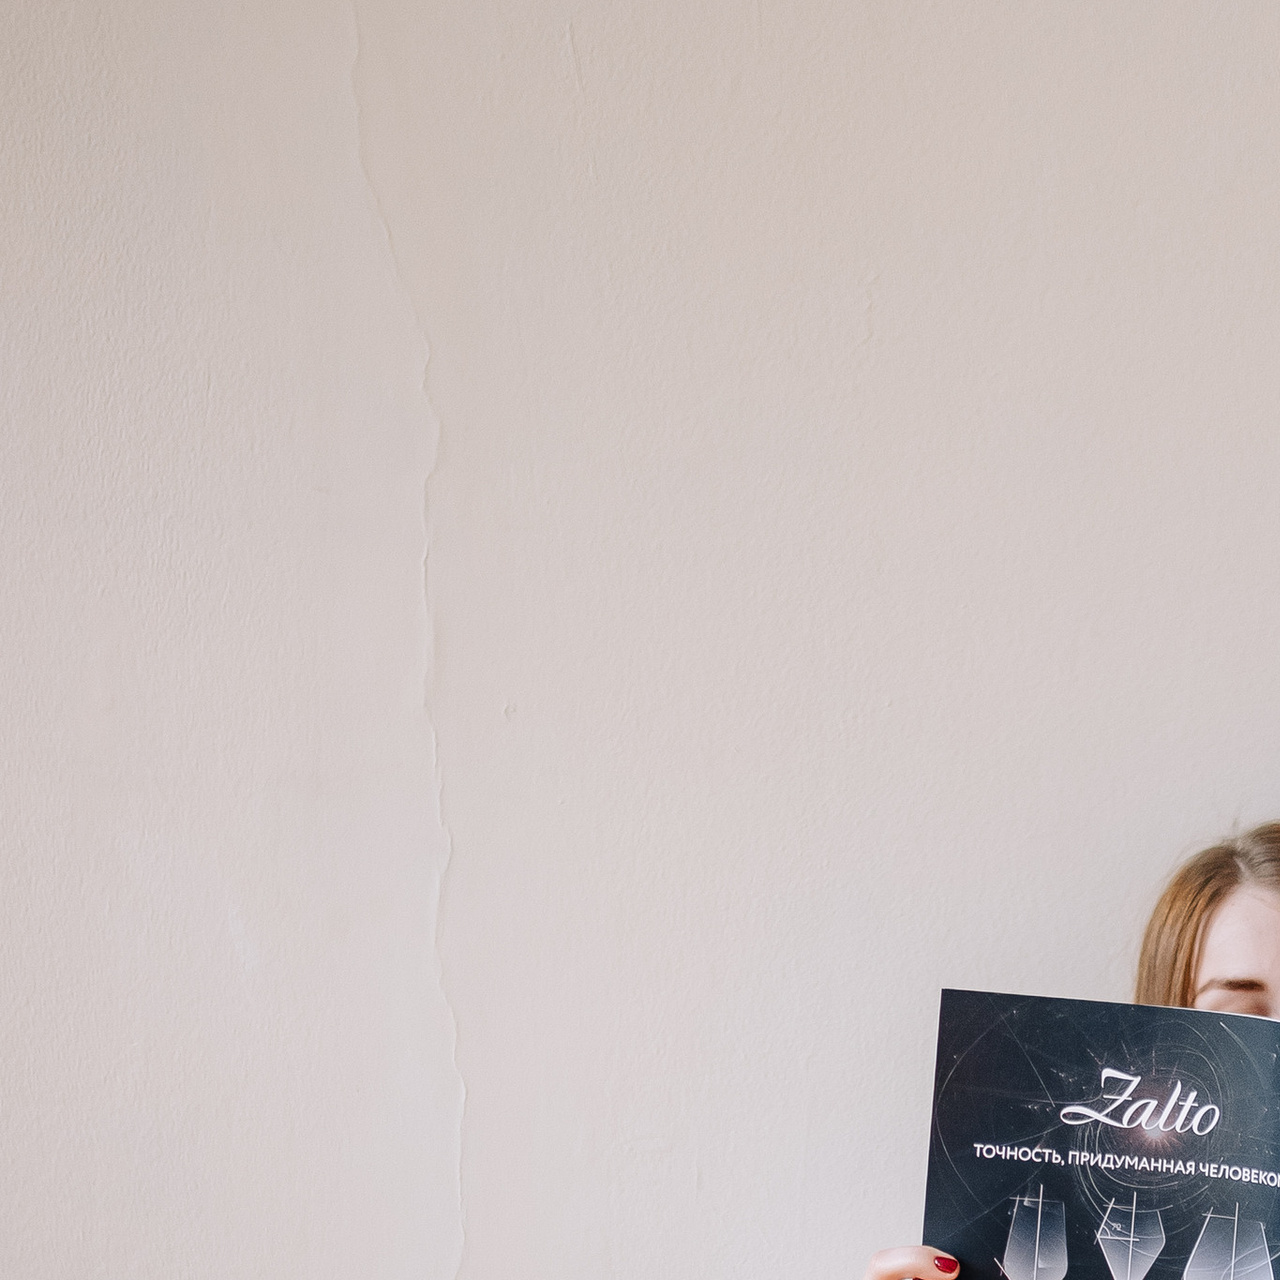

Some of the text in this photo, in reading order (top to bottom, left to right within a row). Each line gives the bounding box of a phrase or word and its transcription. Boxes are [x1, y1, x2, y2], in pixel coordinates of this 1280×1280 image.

[1060, 1068, 1220, 1136] Zalto
[973, 1144, 1065, 1166] ТОЧНОСТЬ,
[1068, 1151, 1196, 1176] ПРИДУМАННАЯ
